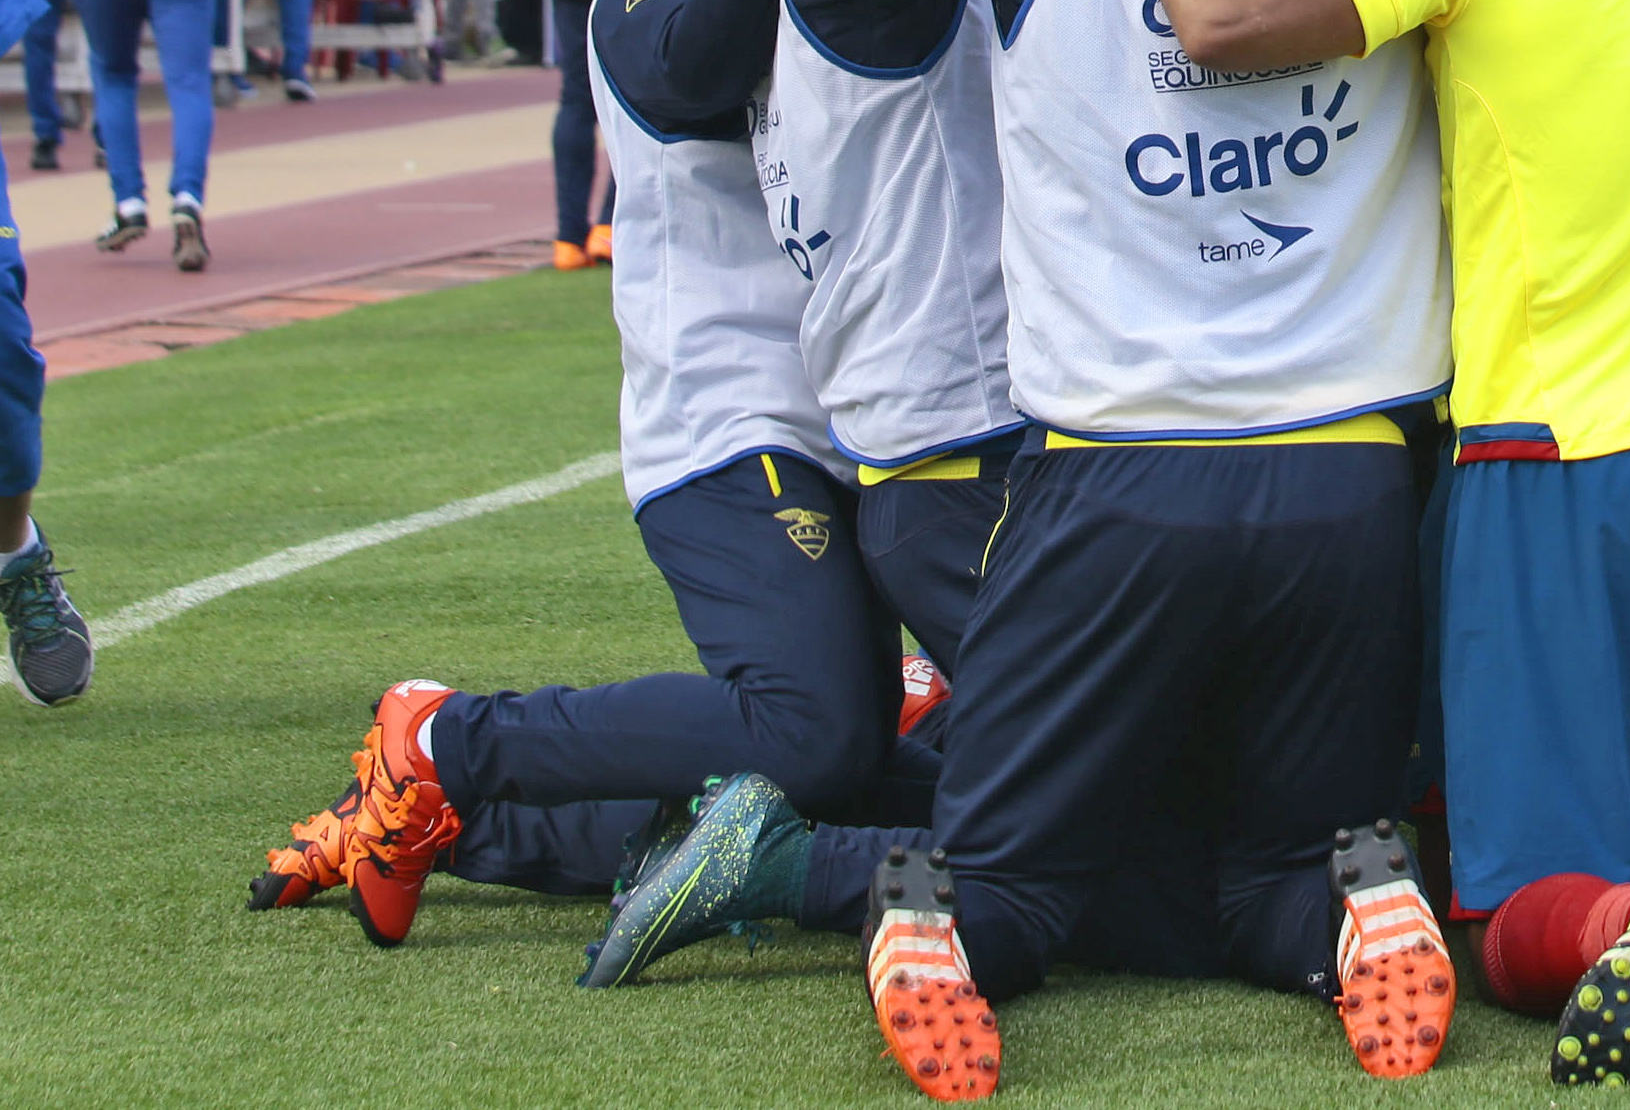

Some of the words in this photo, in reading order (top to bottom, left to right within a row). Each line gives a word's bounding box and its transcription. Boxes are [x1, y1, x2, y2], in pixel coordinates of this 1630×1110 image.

[1147, 49, 1190, 68] SEG
[1124, 124, 1329, 198] Claro
[1197, 237, 1266, 264] tame
